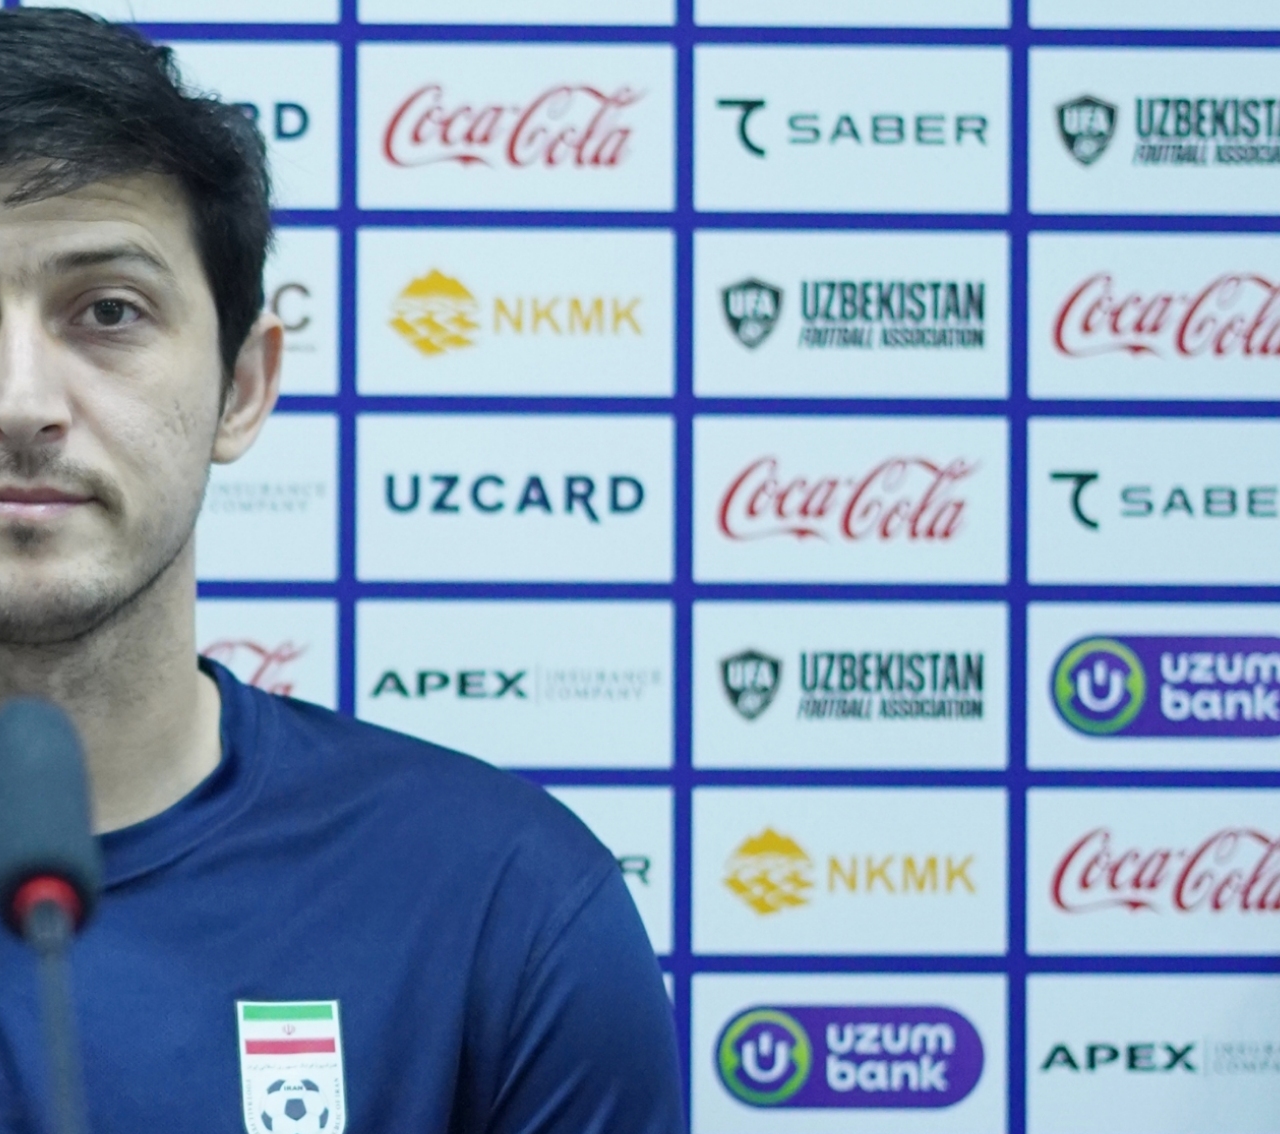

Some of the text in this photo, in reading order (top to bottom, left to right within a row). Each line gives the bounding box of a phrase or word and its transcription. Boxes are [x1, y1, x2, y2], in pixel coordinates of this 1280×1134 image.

[787, 114, 989, 145] SABER
[1135, 98, 1280, 137] UZBEKIST
[493, 296, 642, 335] NKMK
[800, 280, 986, 321] UZBEKISTAN
[384, 473, 645, 523] UZCARD
[371, 670, 527, 699] APEX
[799, 651, 984, 691] UZBEKISTAN
[1162, 684, 1280, 721] bank
[827, 855, 976, 893] NKMK
[825, 1022, 955, 1056] uzum
[1041, 1042, 1197, 1073] APEX
[826, 1056, 950, 1093] bank
